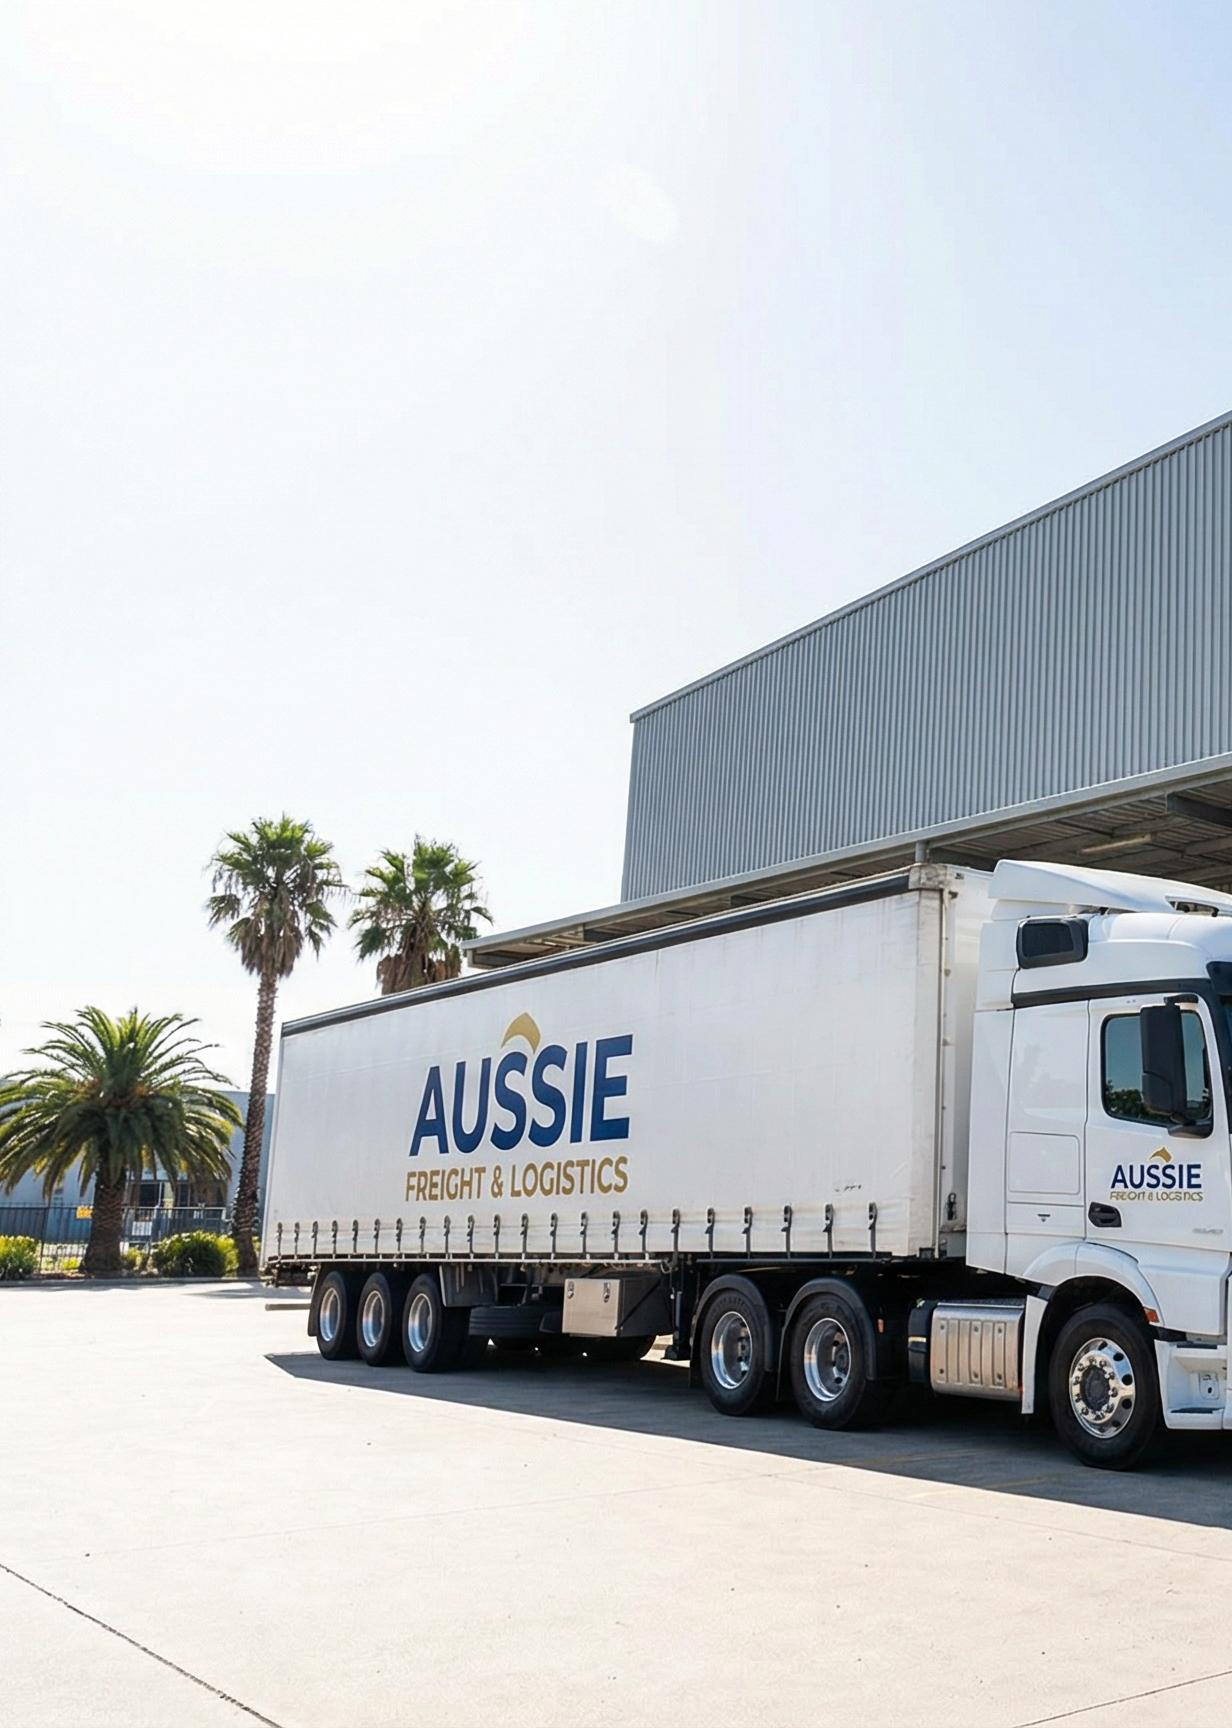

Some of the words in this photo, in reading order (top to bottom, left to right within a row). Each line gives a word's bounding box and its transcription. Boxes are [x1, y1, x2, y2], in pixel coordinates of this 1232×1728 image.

[409, 1034, 633, 1157] AUSSIE
[405, 1166, 486, 1201] FREIGHT
[490, 1164, 503, 1199] &
[510, 1156, 628, 1198] LOGISTICS
[1110, 1163, 1202, 1189] AUSSIE
